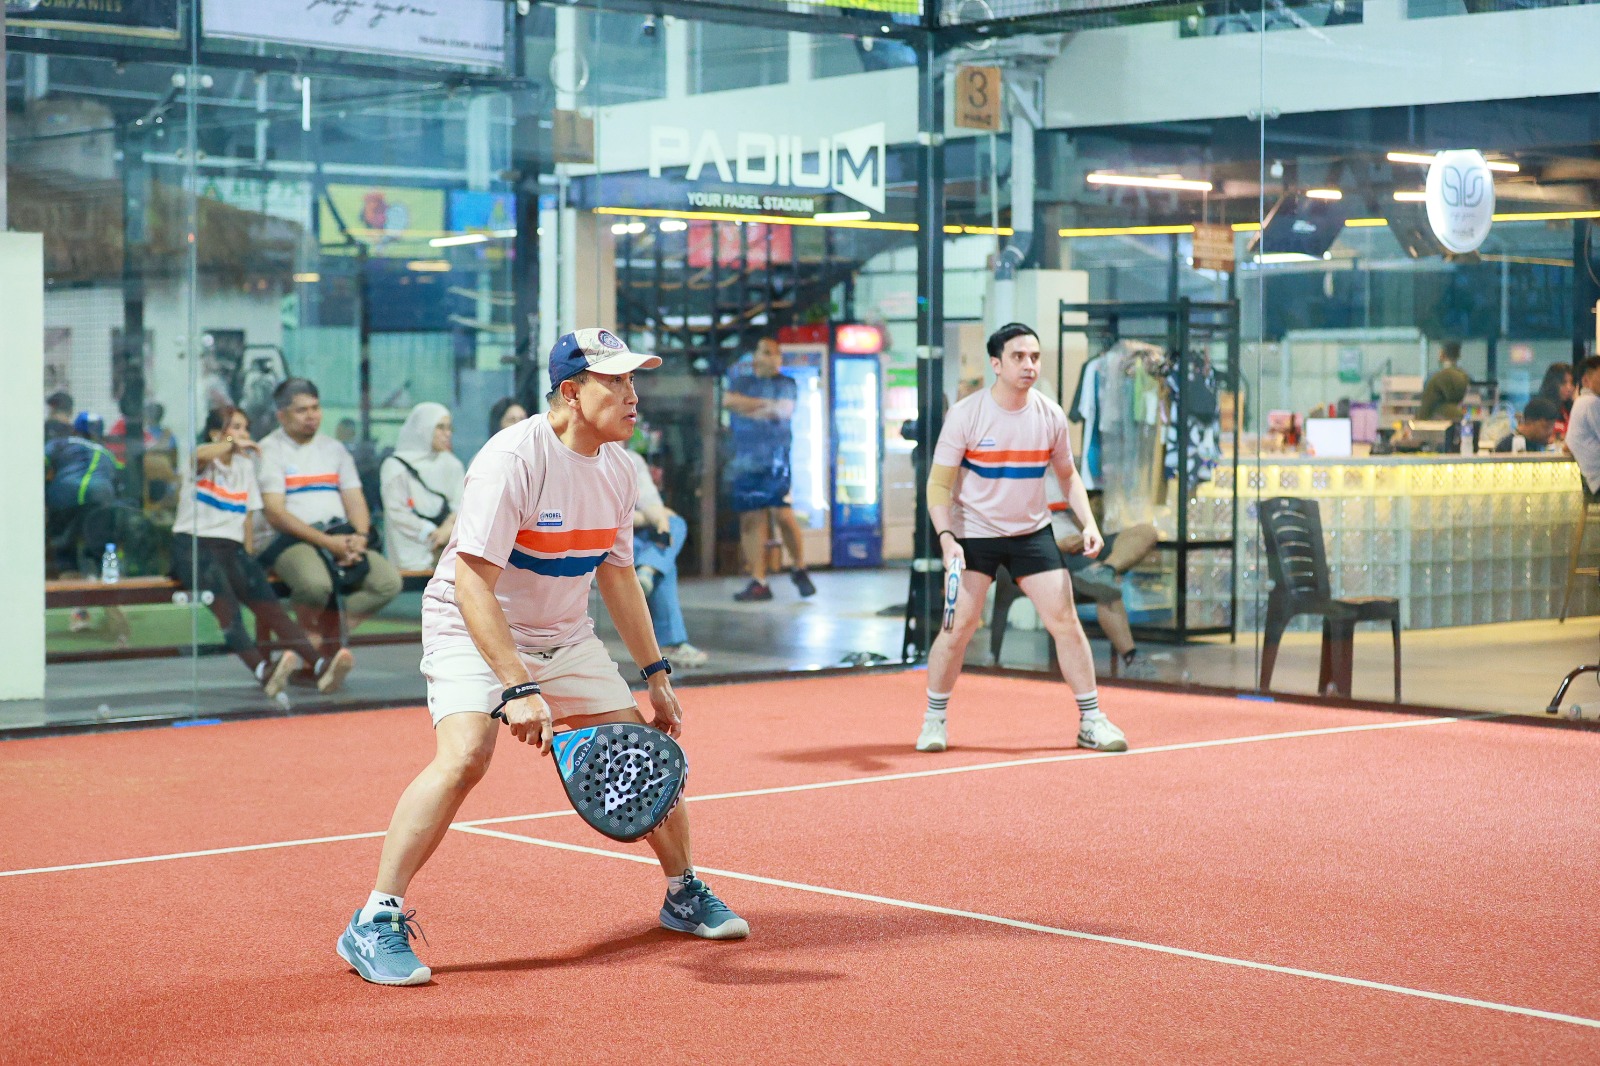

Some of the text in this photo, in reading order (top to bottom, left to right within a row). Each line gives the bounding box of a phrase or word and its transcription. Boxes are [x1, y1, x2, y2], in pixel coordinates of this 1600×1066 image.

[37, 0, 122, 12] OMPANIES
[969, 71, 988, 109] 3
[649, 124, 880, 190] PADIUM
[687, 192, 814, 212] YOUR PADEL STADIUM
